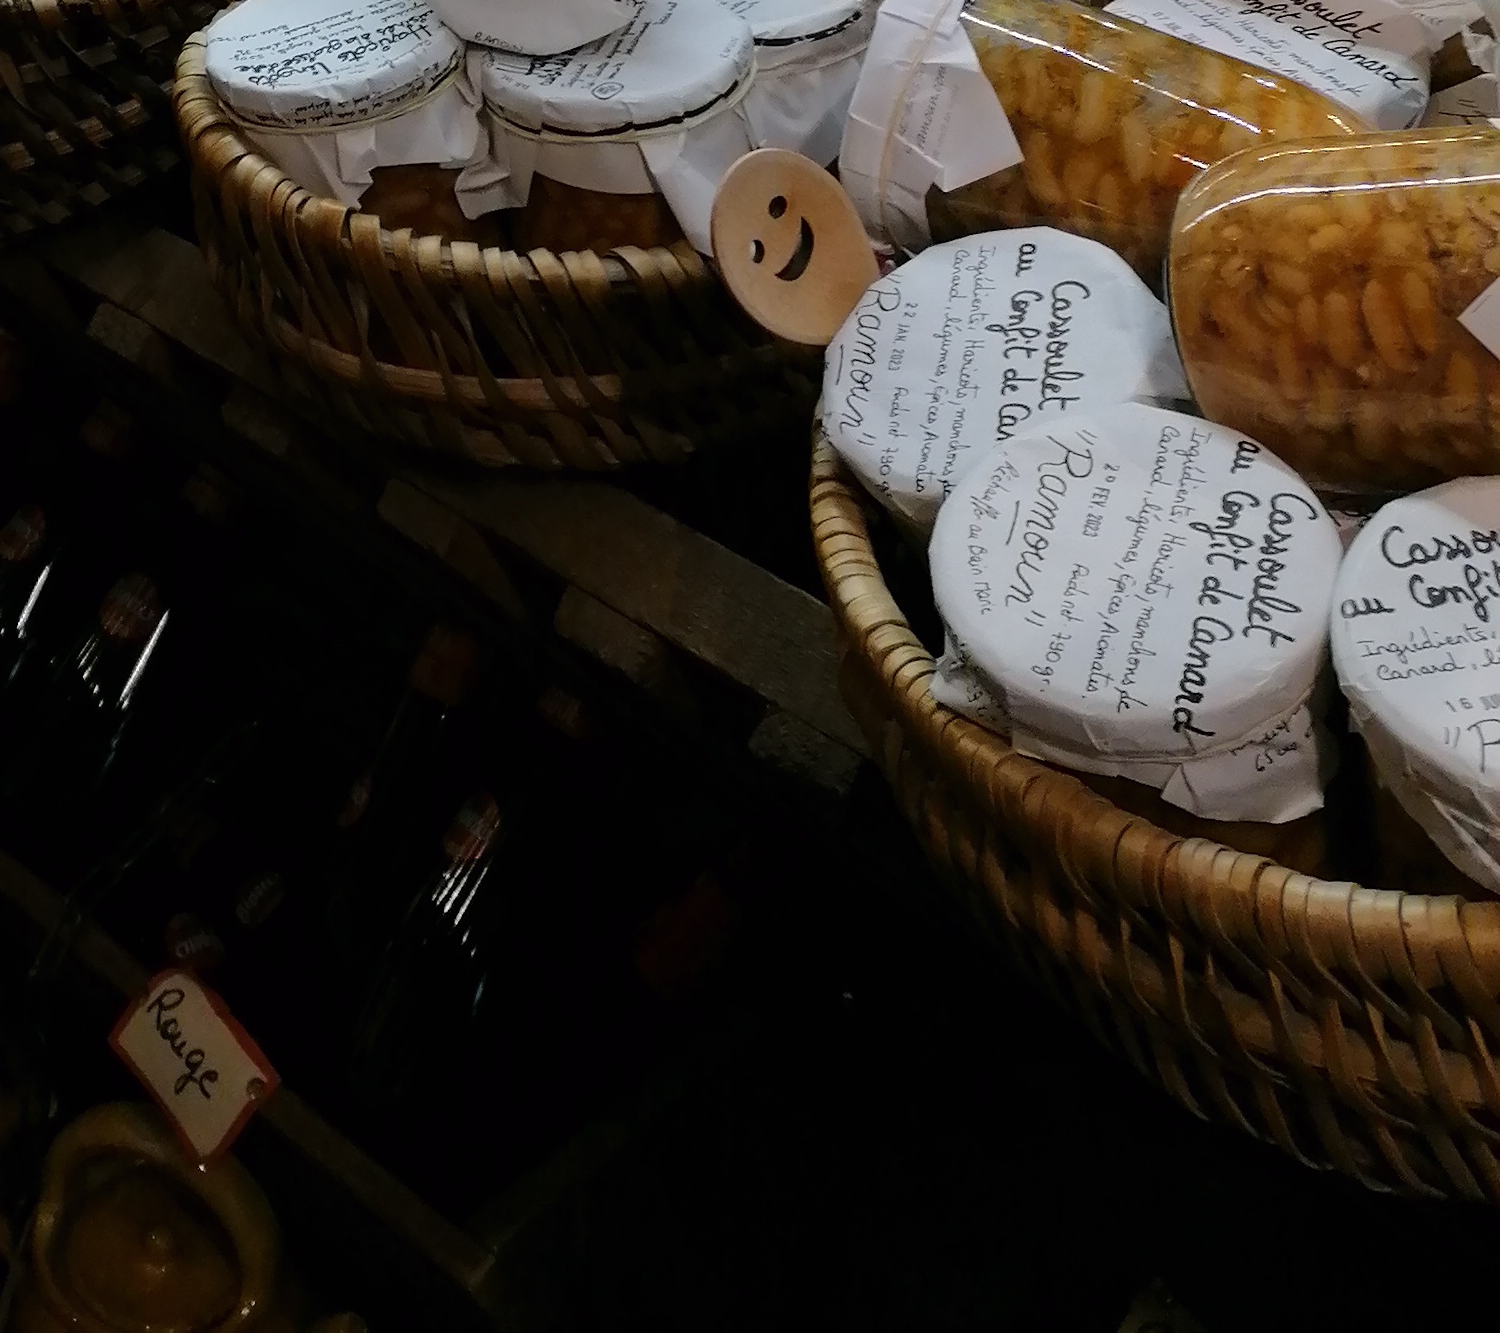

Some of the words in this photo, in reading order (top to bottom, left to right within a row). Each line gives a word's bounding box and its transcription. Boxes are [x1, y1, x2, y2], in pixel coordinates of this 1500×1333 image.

[1292, 24, 1320, 41] de
[1322, 39, 1418, 91] Canard
[1015, 243, 1039, 278] au
[985, 290, 1044, 361] Confit
[1037, 280, 1091, 412] Cassoulet
[1001, 367, 1039, 397] de
[1229, 439, 1261, 475] au
[1188, 489, 1262, 572] Confit
[1198, 575, 1246, 607] de
[1243, 491, 1319, 649] Cassoulet
[1340, 597, 1396, 619] au
[1171, 614, 1235, 739] Canard
[147, 988, 219, 1100] Rouge
